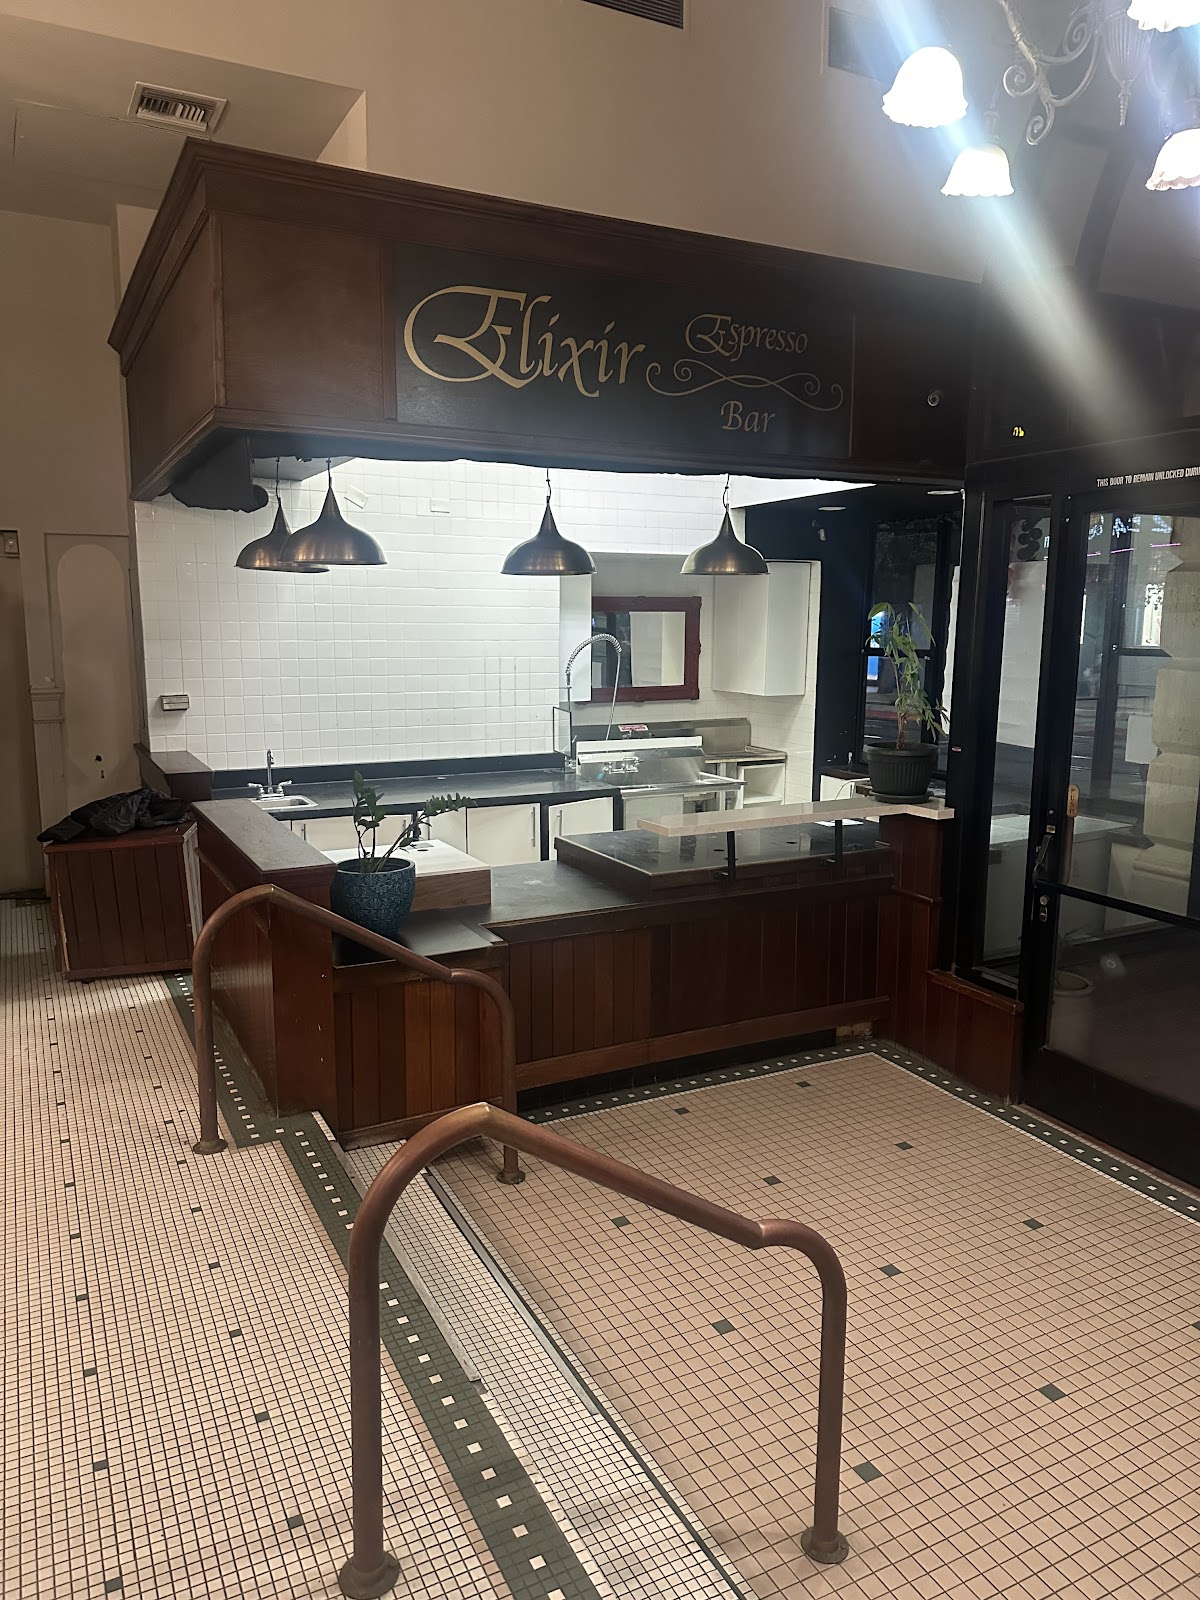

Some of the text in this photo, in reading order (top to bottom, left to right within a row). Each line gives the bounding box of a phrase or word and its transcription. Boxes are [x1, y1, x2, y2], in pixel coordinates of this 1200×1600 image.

[404, 285, 646, 397] Elixir
[685, 313, 808, 362] Espresso
[720, 400, 776, 433] Bar
[1096, 478, 1109, 487] THIS
[1110, 476, 1124, 486] DOOR
[1125, 474, 1132, 484] TO
[1133, 472, 1154, 483] REMAIN
[1155, 468, 1184, 481] UNLOCKED
